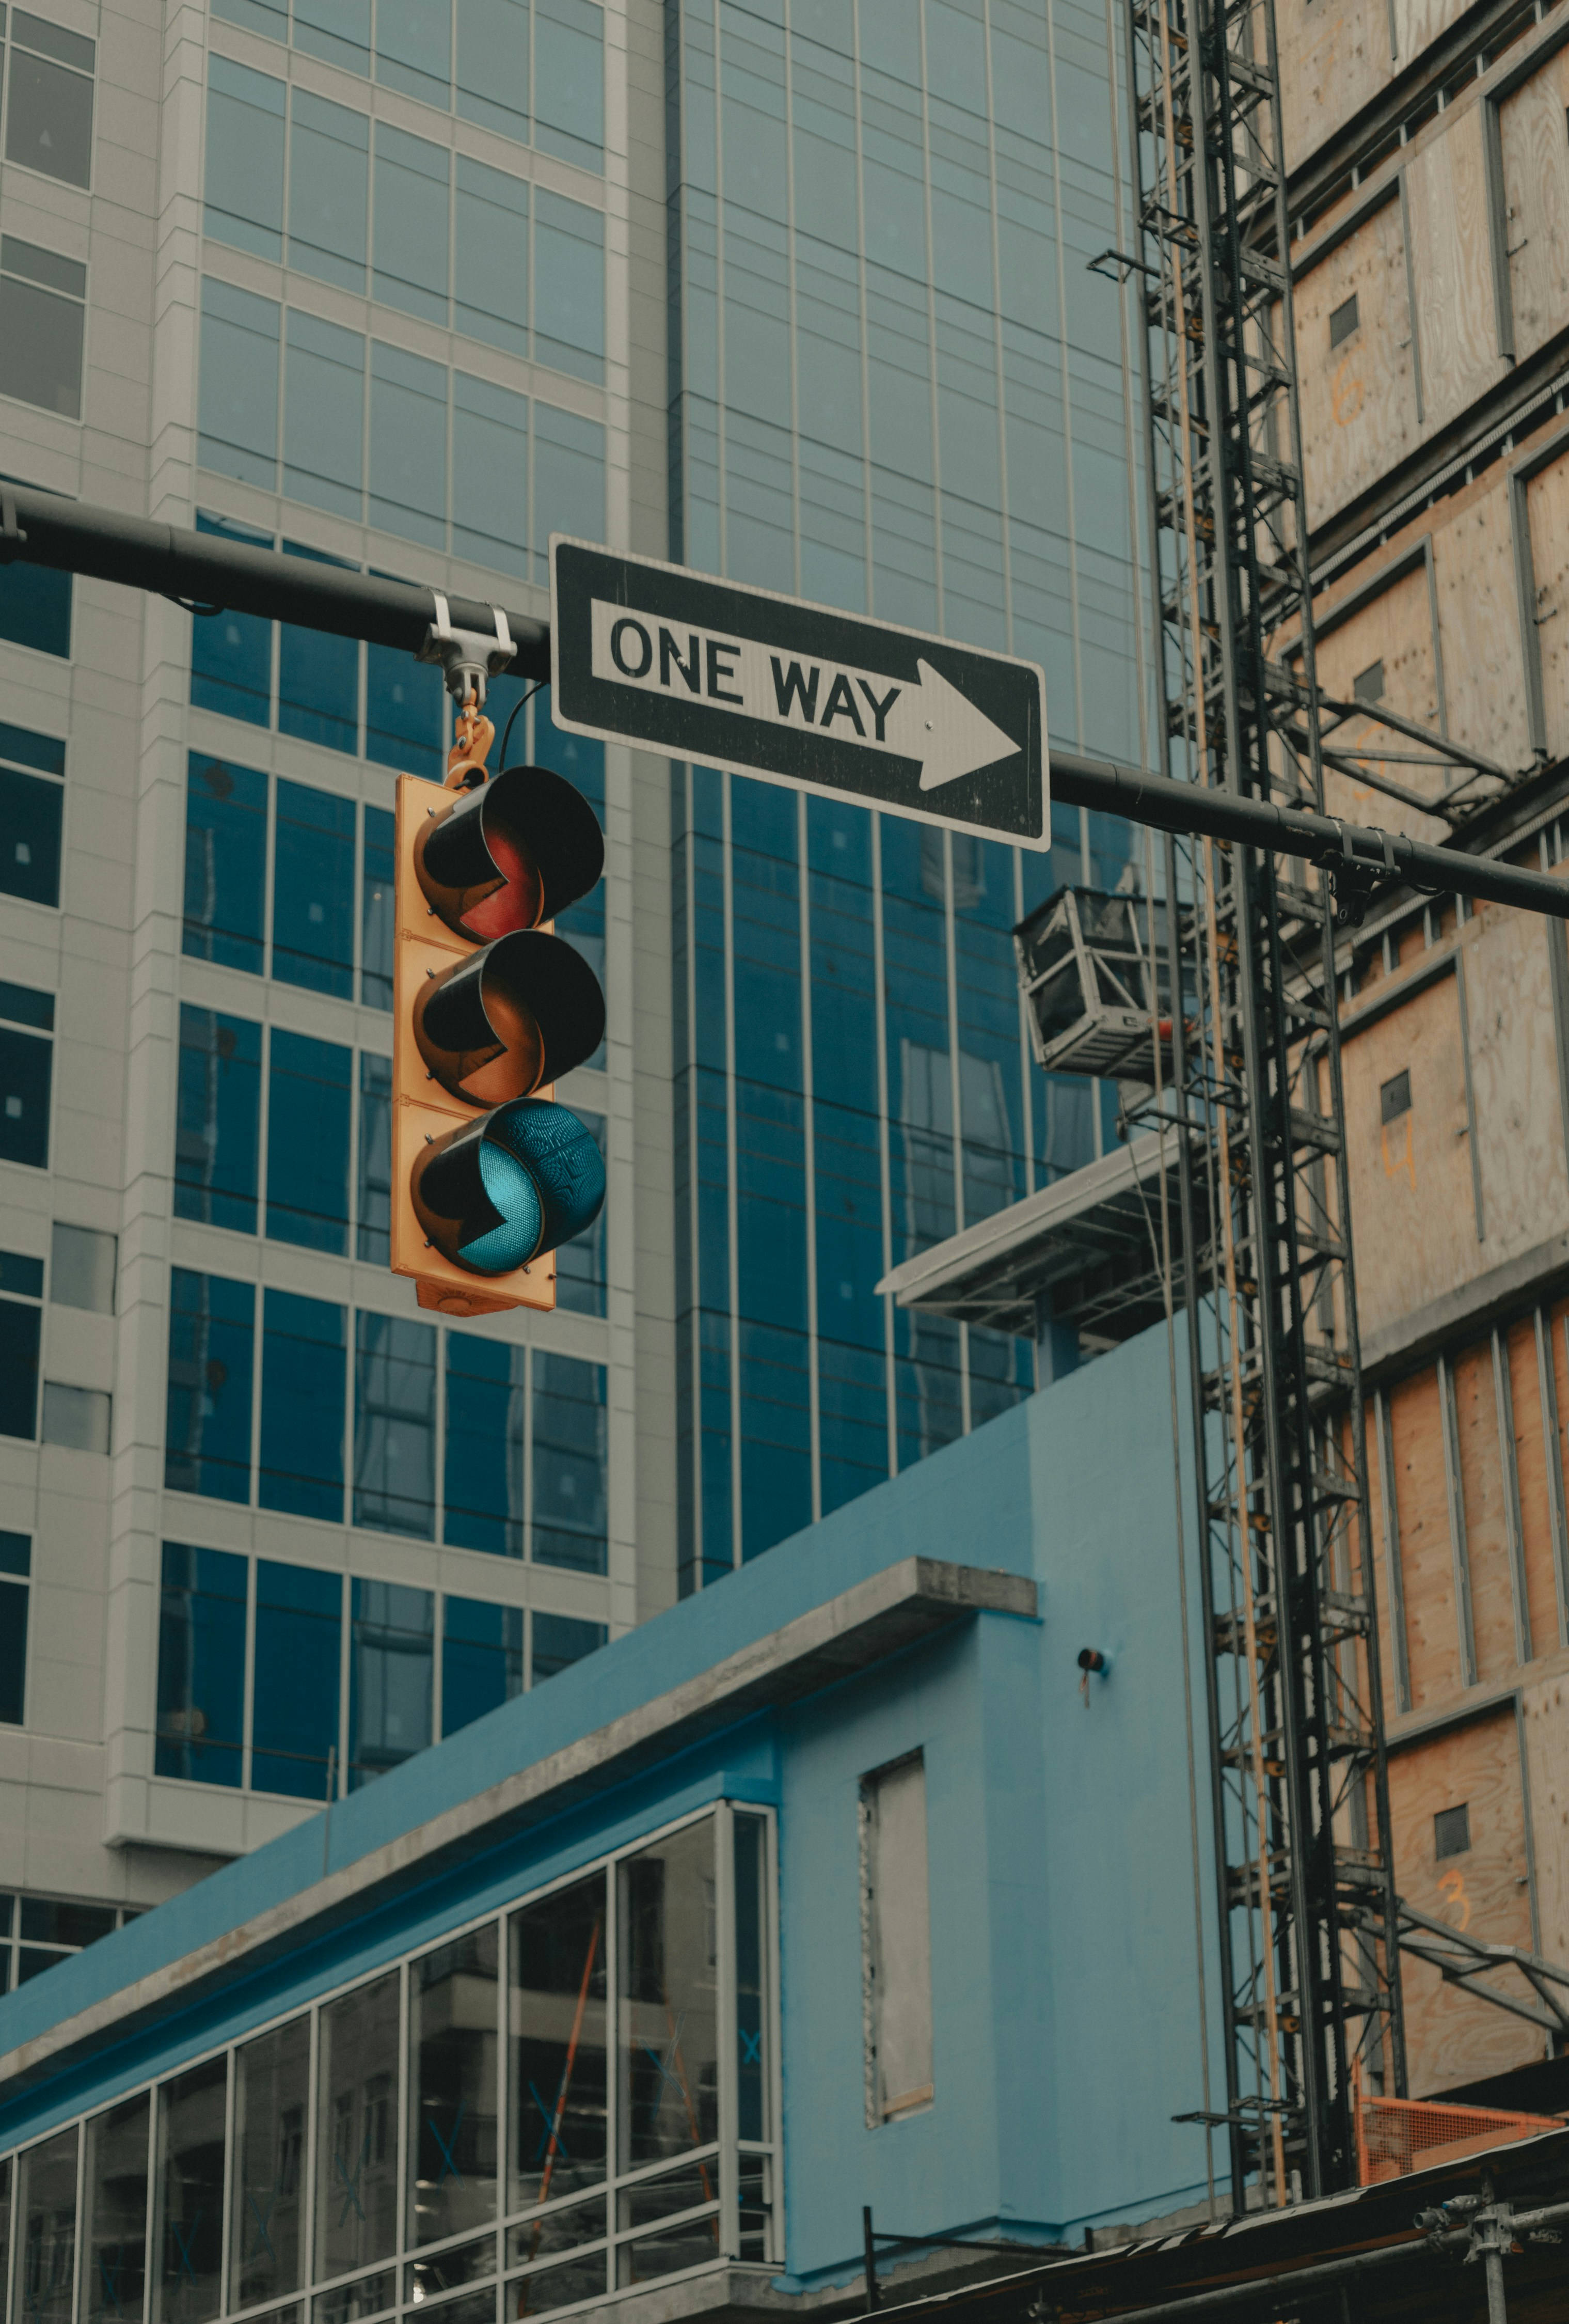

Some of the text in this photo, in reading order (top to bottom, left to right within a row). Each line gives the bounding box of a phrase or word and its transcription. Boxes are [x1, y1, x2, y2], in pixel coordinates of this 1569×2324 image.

[1332, 342, 1366, 427] 6
[611, 618, 901, 742] ONE WAY
[1381, 1110, 1417, 1192] 4
[1437, 1867, 1471, 1932] 3
